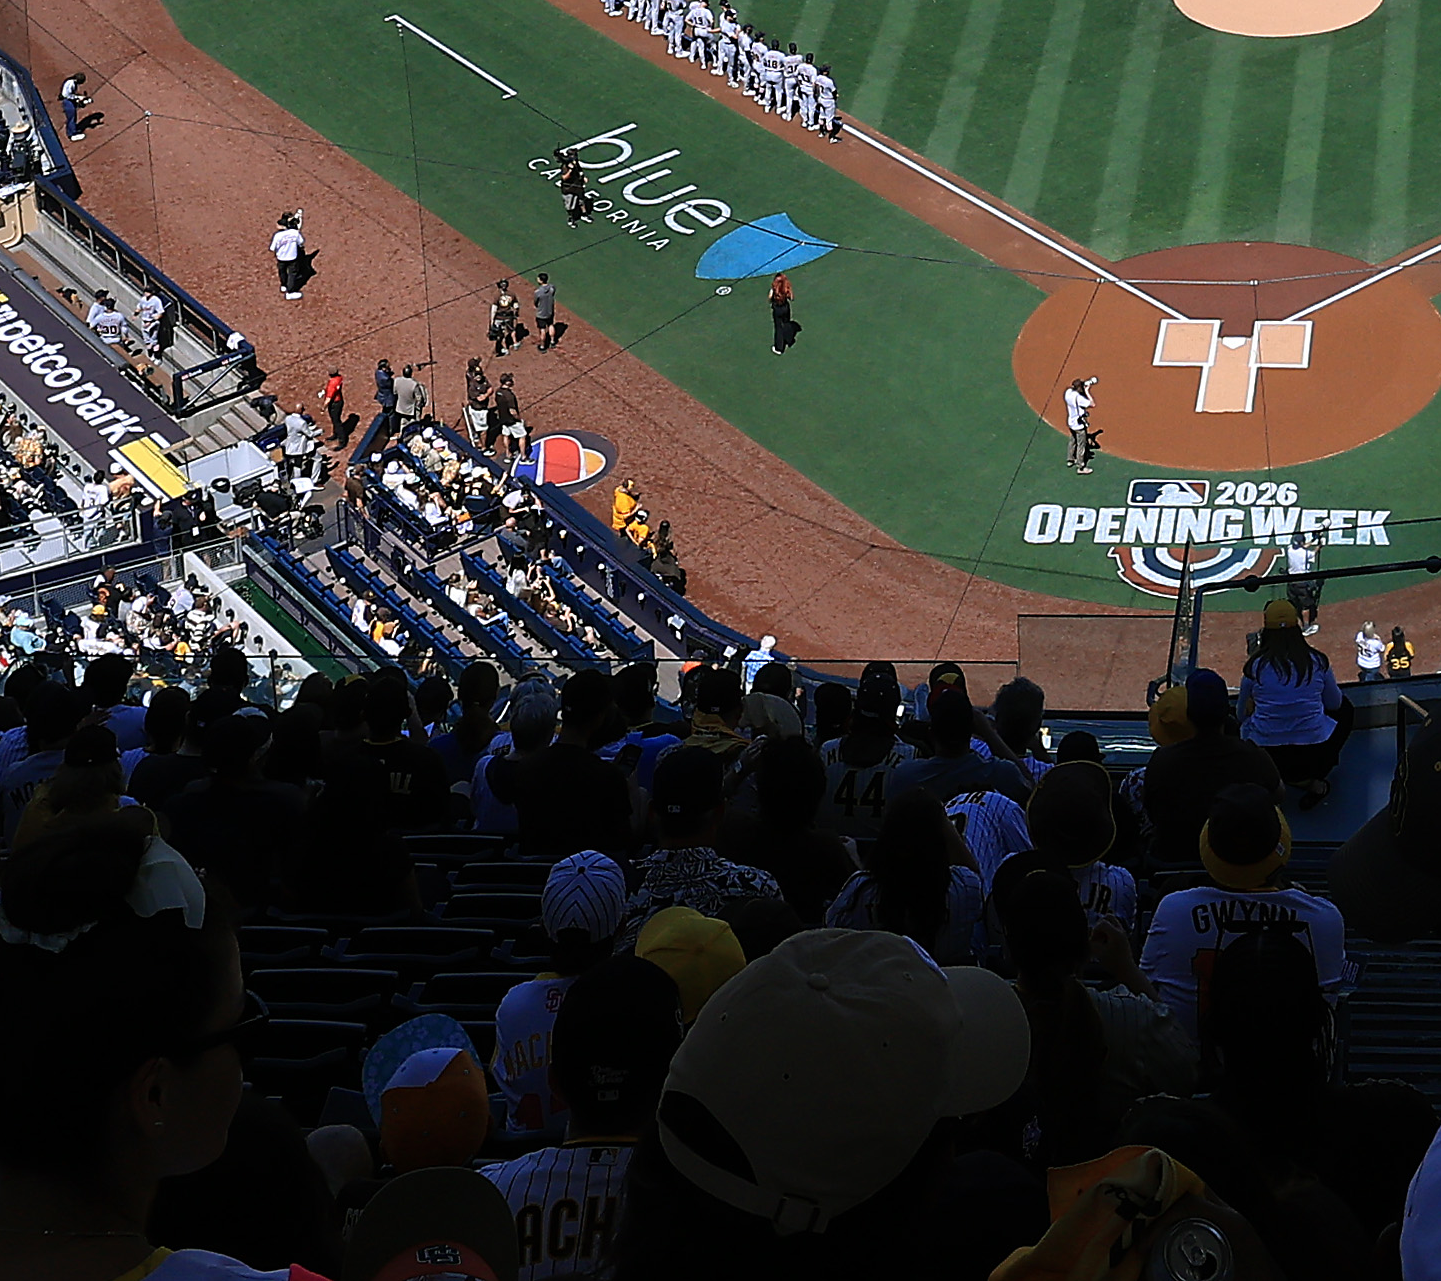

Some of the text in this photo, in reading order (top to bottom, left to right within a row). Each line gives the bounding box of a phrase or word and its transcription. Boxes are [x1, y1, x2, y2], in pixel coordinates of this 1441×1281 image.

[560, 122, 732, 235] blue
[47, 379, 145, 445] park
[1213, 481, 1299, 507] 2026
[1024, 503, 1392, 547] OPENING WEEK
[832, 769, 887, 818] 44
